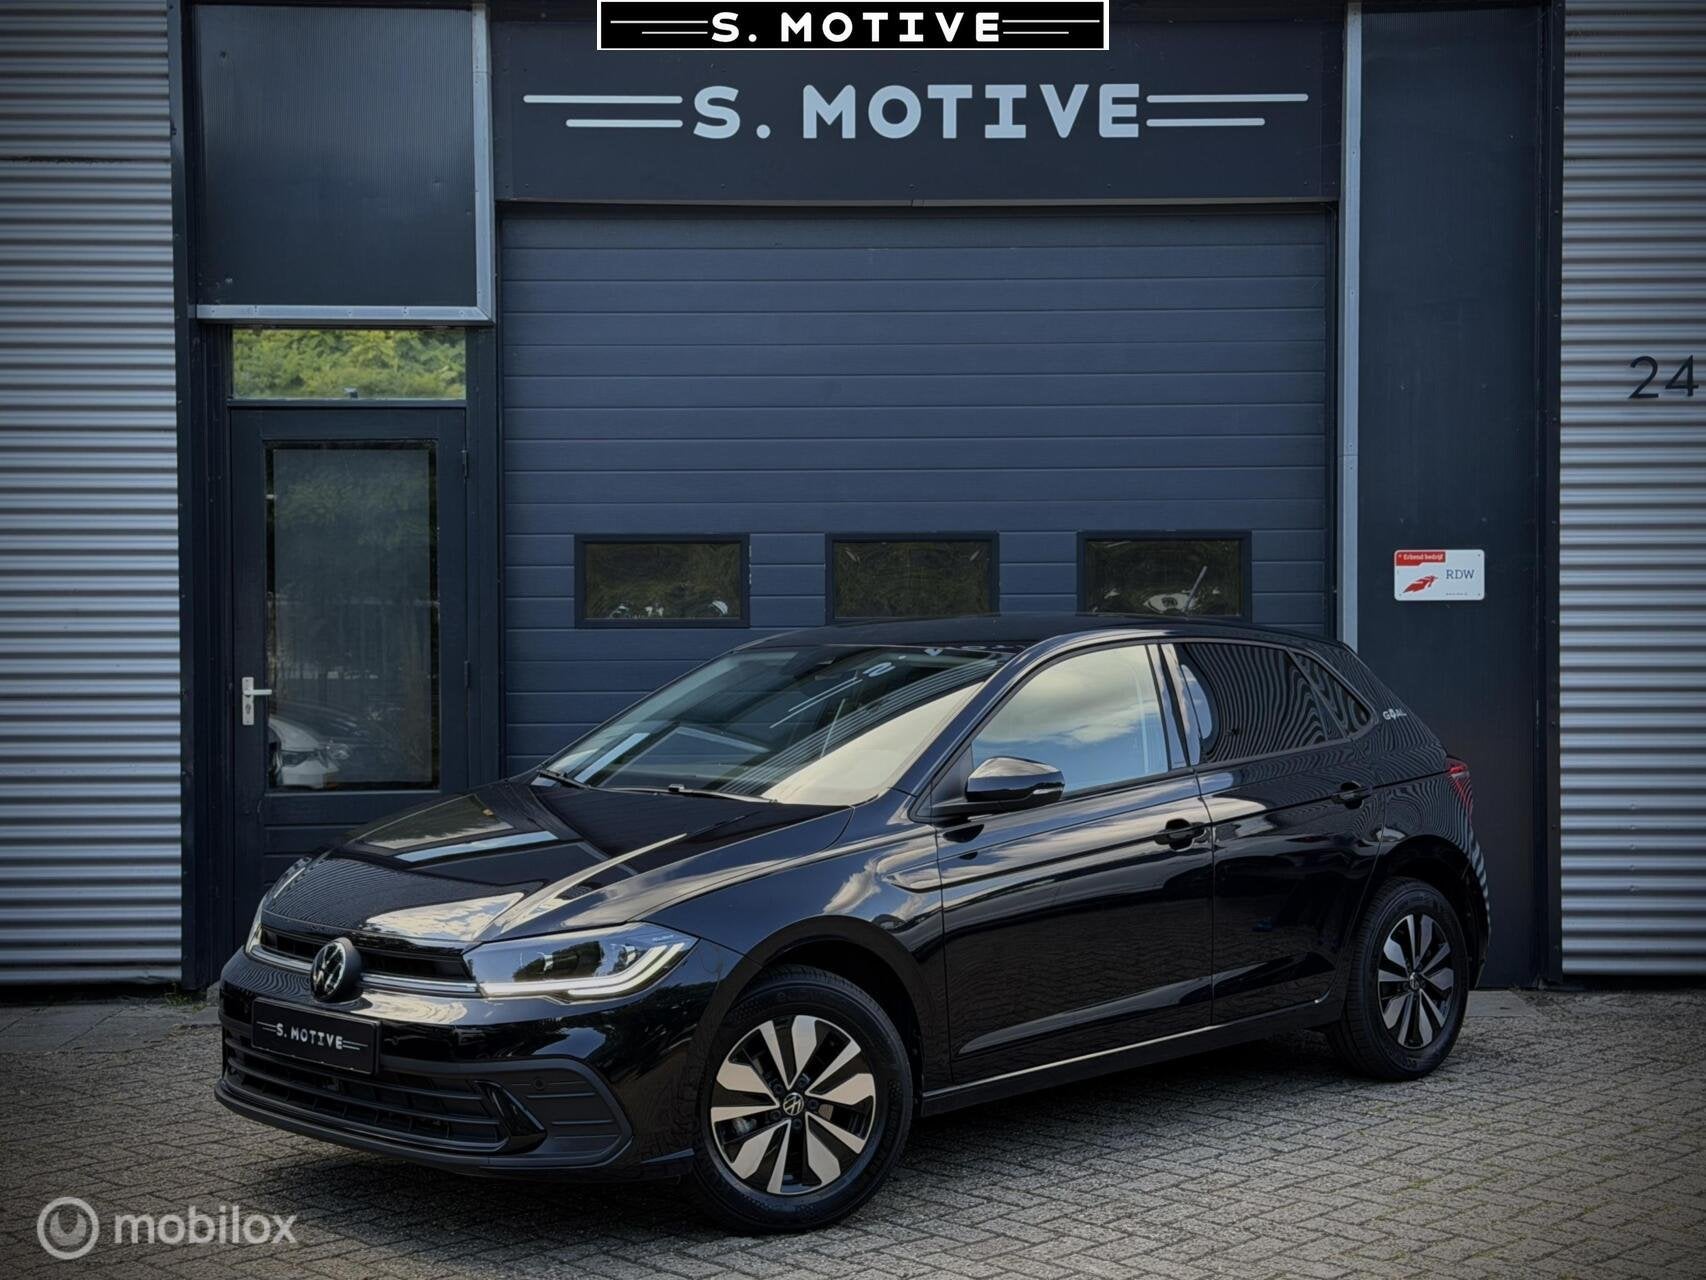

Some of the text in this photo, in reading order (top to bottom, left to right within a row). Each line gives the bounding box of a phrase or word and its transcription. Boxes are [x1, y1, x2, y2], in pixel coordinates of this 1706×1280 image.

[693, 82, 1141, 140] S. MOTIVE
[1628, 354, 1700, 399] 24
[1446, 569, 1475, 579] RDW
[276, 1023, 343, 1050] S. MOTIVE
